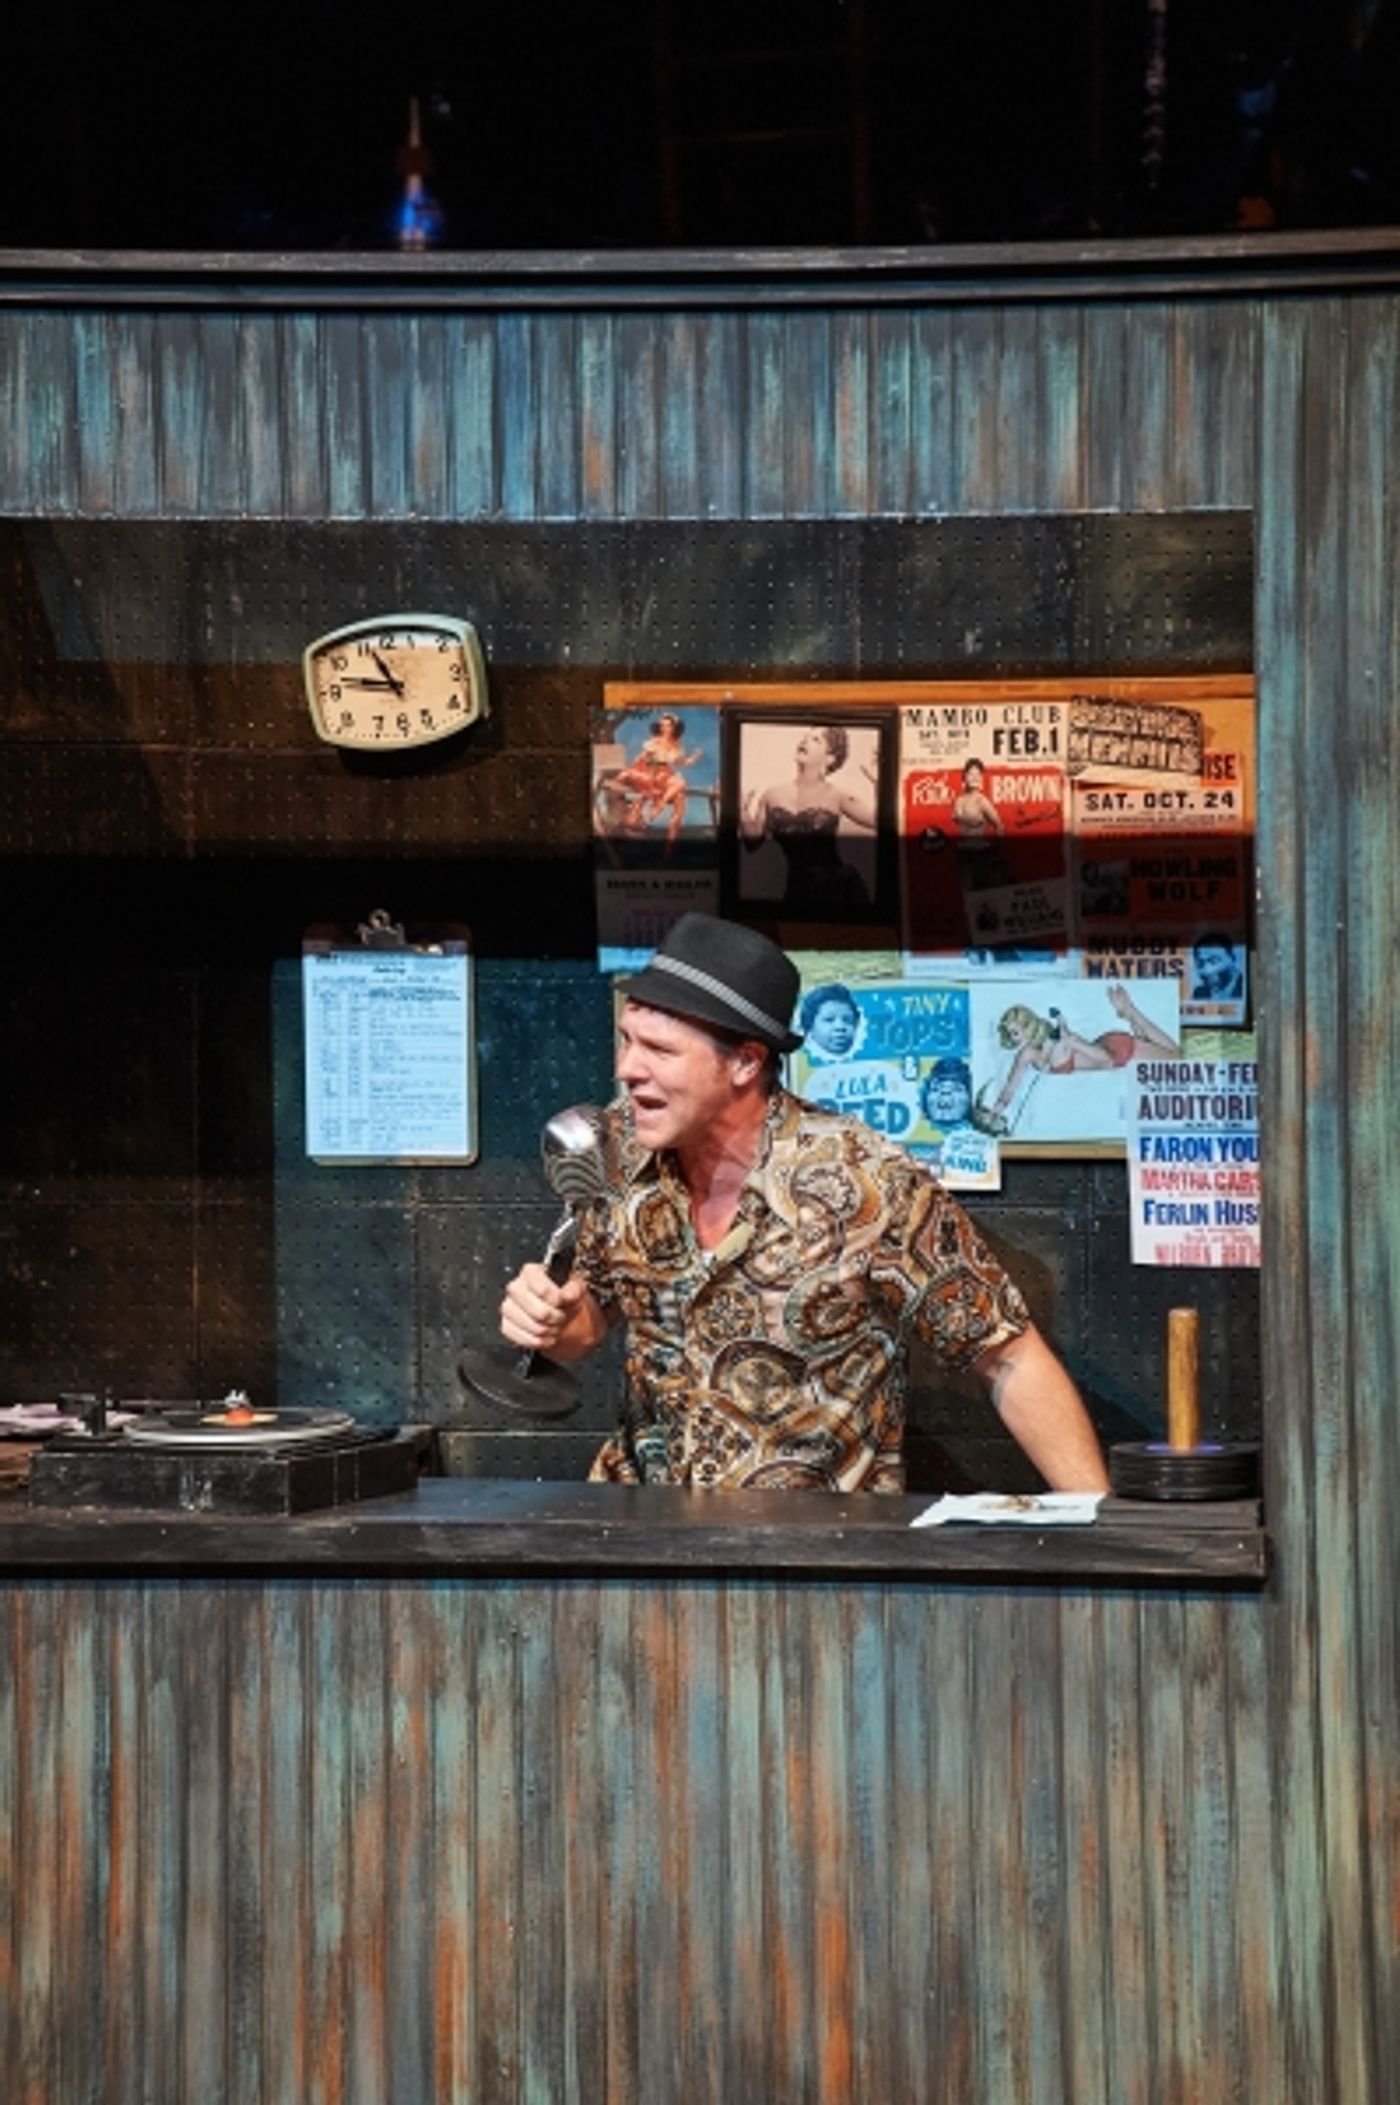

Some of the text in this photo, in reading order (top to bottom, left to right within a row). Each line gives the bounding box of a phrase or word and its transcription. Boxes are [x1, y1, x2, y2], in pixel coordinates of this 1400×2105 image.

[906, 708, 988, 727] MAMBO
[1003, 705, 1061, 724] CLUB
[1202, 754, 1237, 780] ISE
[992, 775, 1061, 804] BROWN
[1085, 790, 1235, 811] SAT. OCT. 24
[1148, 881, 1222, 901] WOLF
[1087, 934, 1180, 955] MUDDY
[1087, 957, 1184, 978] WATERS
[902, 993, 951, 1016] TINY
[835, 1074, 887, 1099] LULA
[1140, 1137, 1212, 1162] FARON
[1141, 1169, 1211, 1191] MARTHA
[1214, 1199, 1260, 1225] HUS
